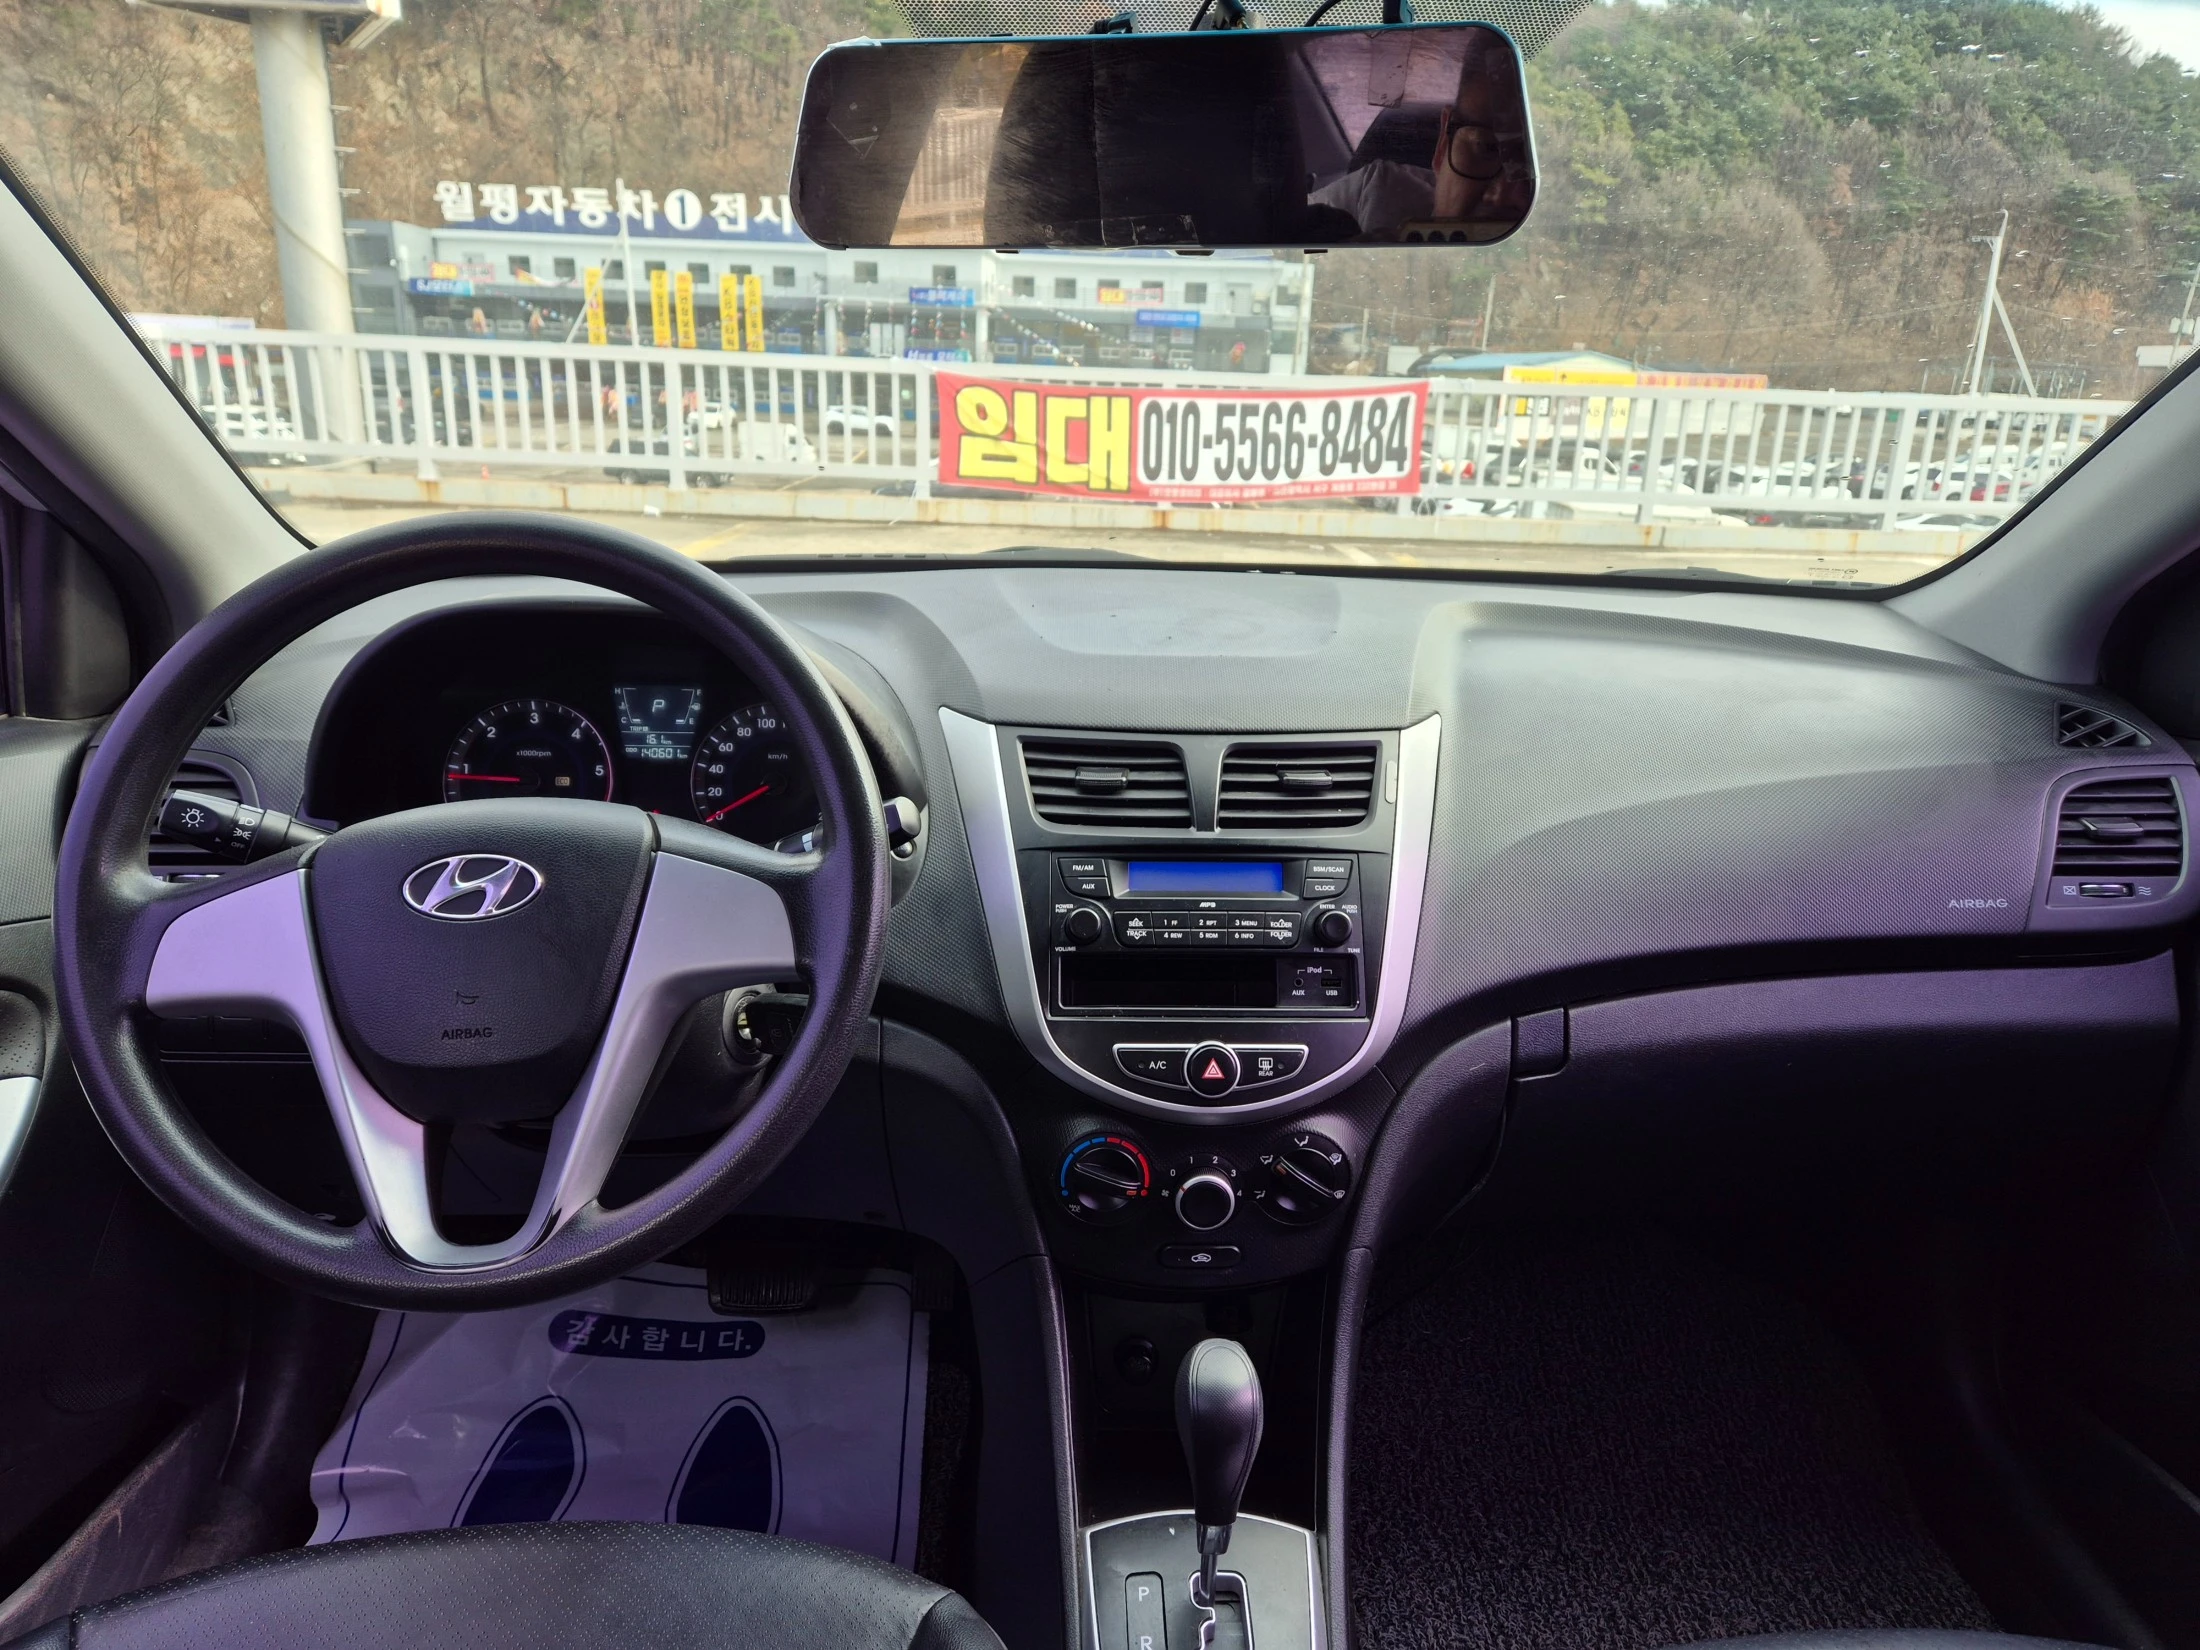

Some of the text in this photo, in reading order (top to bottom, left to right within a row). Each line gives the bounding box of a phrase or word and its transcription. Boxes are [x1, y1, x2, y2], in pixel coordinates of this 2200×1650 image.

[433, 180, 658, 231] 월평자동차
[955, 385, 1412, 493] 임대 010-5566-8484
[652, 699, 665, 713] P
[529, 712, 540, 724] 3
[756, 718, 776, 729] 100
[486, 726, 496, 738] 2
[571, 727, 581, 739] 4
[736, 727, 752, 737] 80
[718, 742, 734, 752] 60
[462, 763, 469, 775] 1
[594, 764, 605, 777] 5
[708, 764, 724, 774] 40
[707, 787, 723, 797] 20
[1312, 865, 1345, 873] BSM/SCAN
[1314, 884, 1336, 892] CLOCK
[1948, 898, 2009, 908] AIRBAG
[1163, 931, 1169, 939] 4
[1307, 966, 1323, 974] iPod
[1291, 989, 1306, 997] AUX
[1325, 989, 1339, 997] USB
[441, 1027, 493, 1041] AIRBAG
[1148, 1060, 1168, 1070] A/C
[1189, 1156, 1194, 1165] 1
[1212, 1155, 1219, 1165] 2
[1169, 1168, 1177, 1177] 0
[1230, 1169, 1237, 1178] 3
[1236, 1189, 1243, 1197] 4
[1138, 1586, 1150, 1602] P
[1140, 1635, 1152, 1650] R
